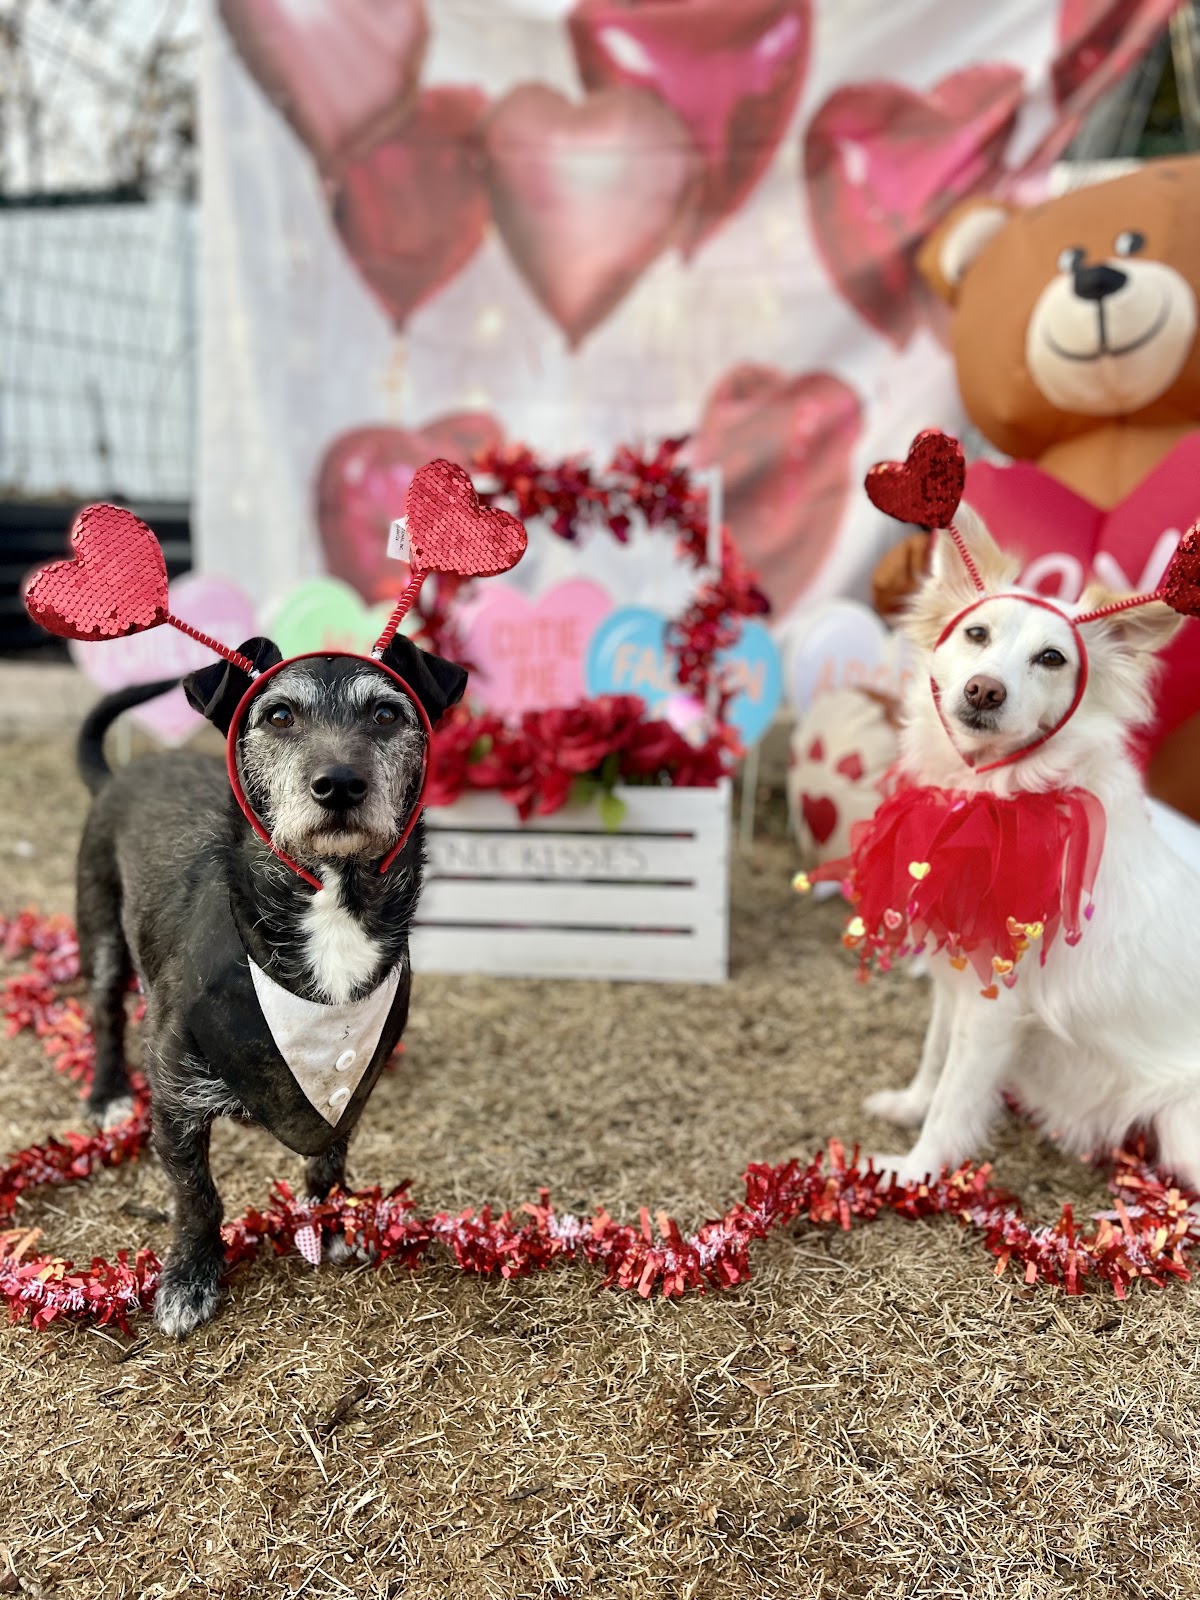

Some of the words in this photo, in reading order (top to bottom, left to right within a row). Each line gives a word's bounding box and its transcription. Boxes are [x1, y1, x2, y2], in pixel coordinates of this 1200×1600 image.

[490, 617, 578, 659] CUTIE
[513, 662, 560, 700] PIE
[520, 843, 649, 874] KISSES
